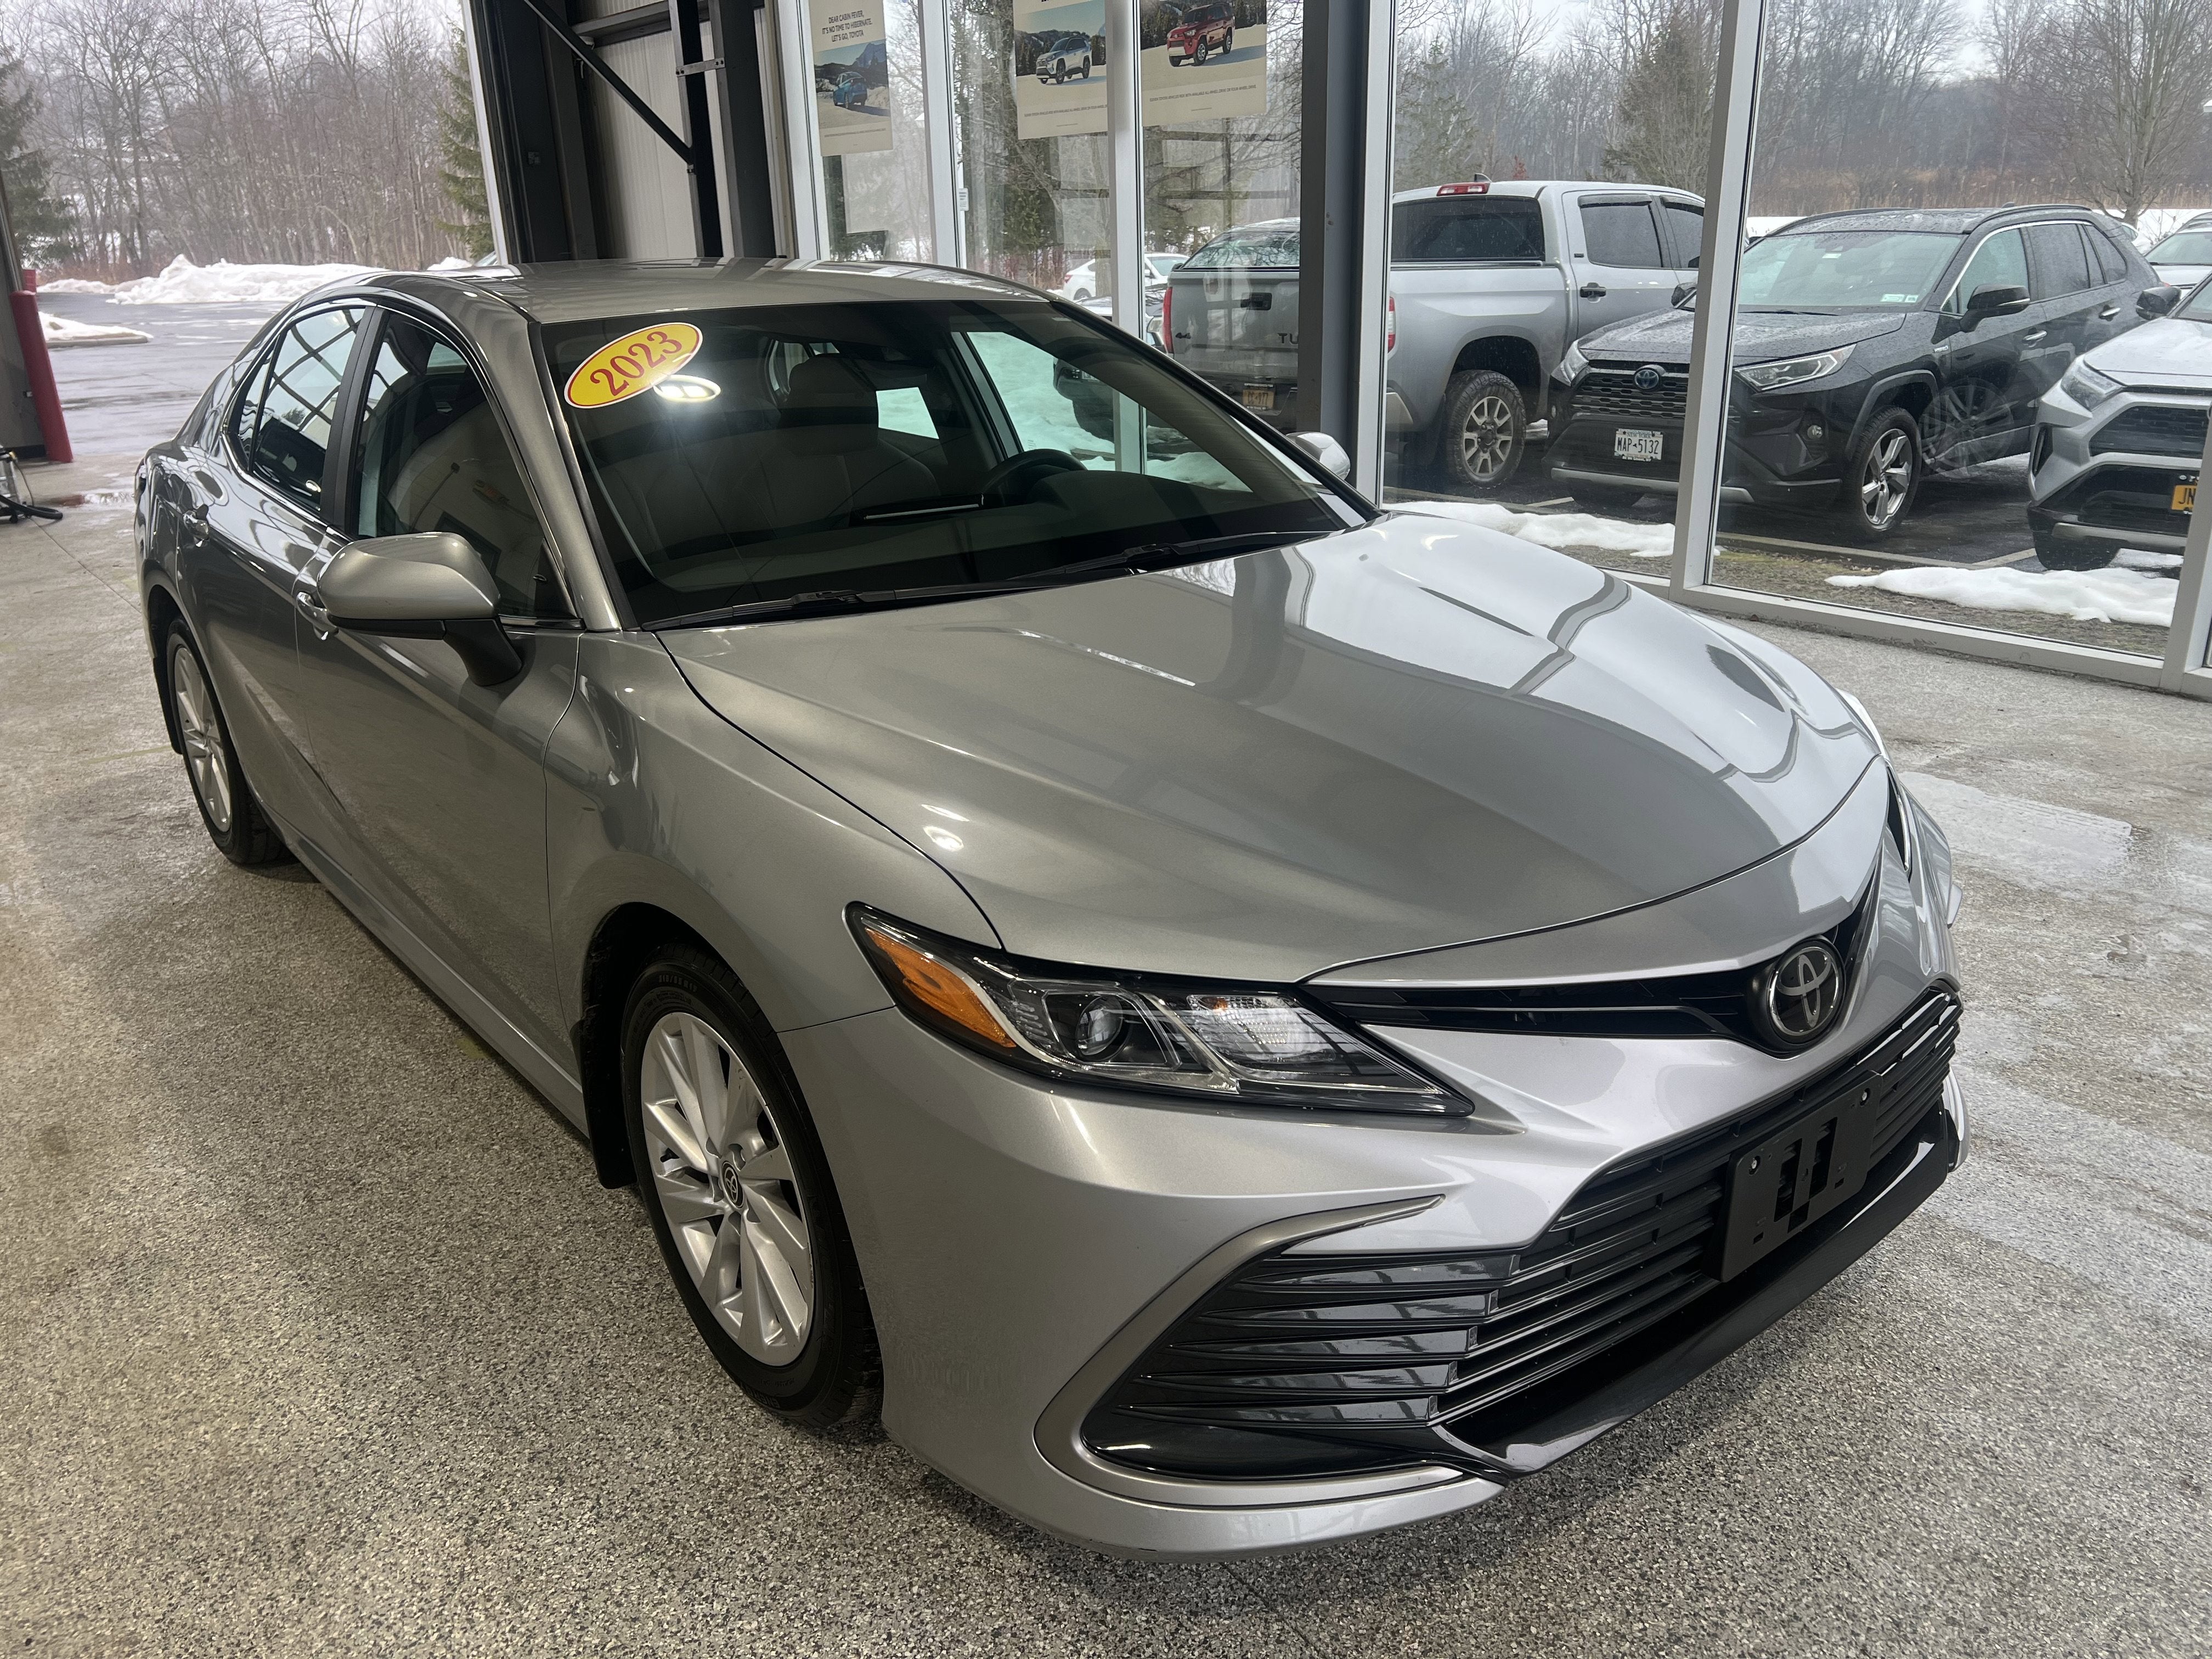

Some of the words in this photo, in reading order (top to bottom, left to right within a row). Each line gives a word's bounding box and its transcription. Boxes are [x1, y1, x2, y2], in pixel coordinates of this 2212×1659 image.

[829, 15, 838, 24] DEAR
[849, 30, 864, 38] TOYOTA
[590, 331, 682, 396] 2023
[1638, 439, 1660, 454] 5132
